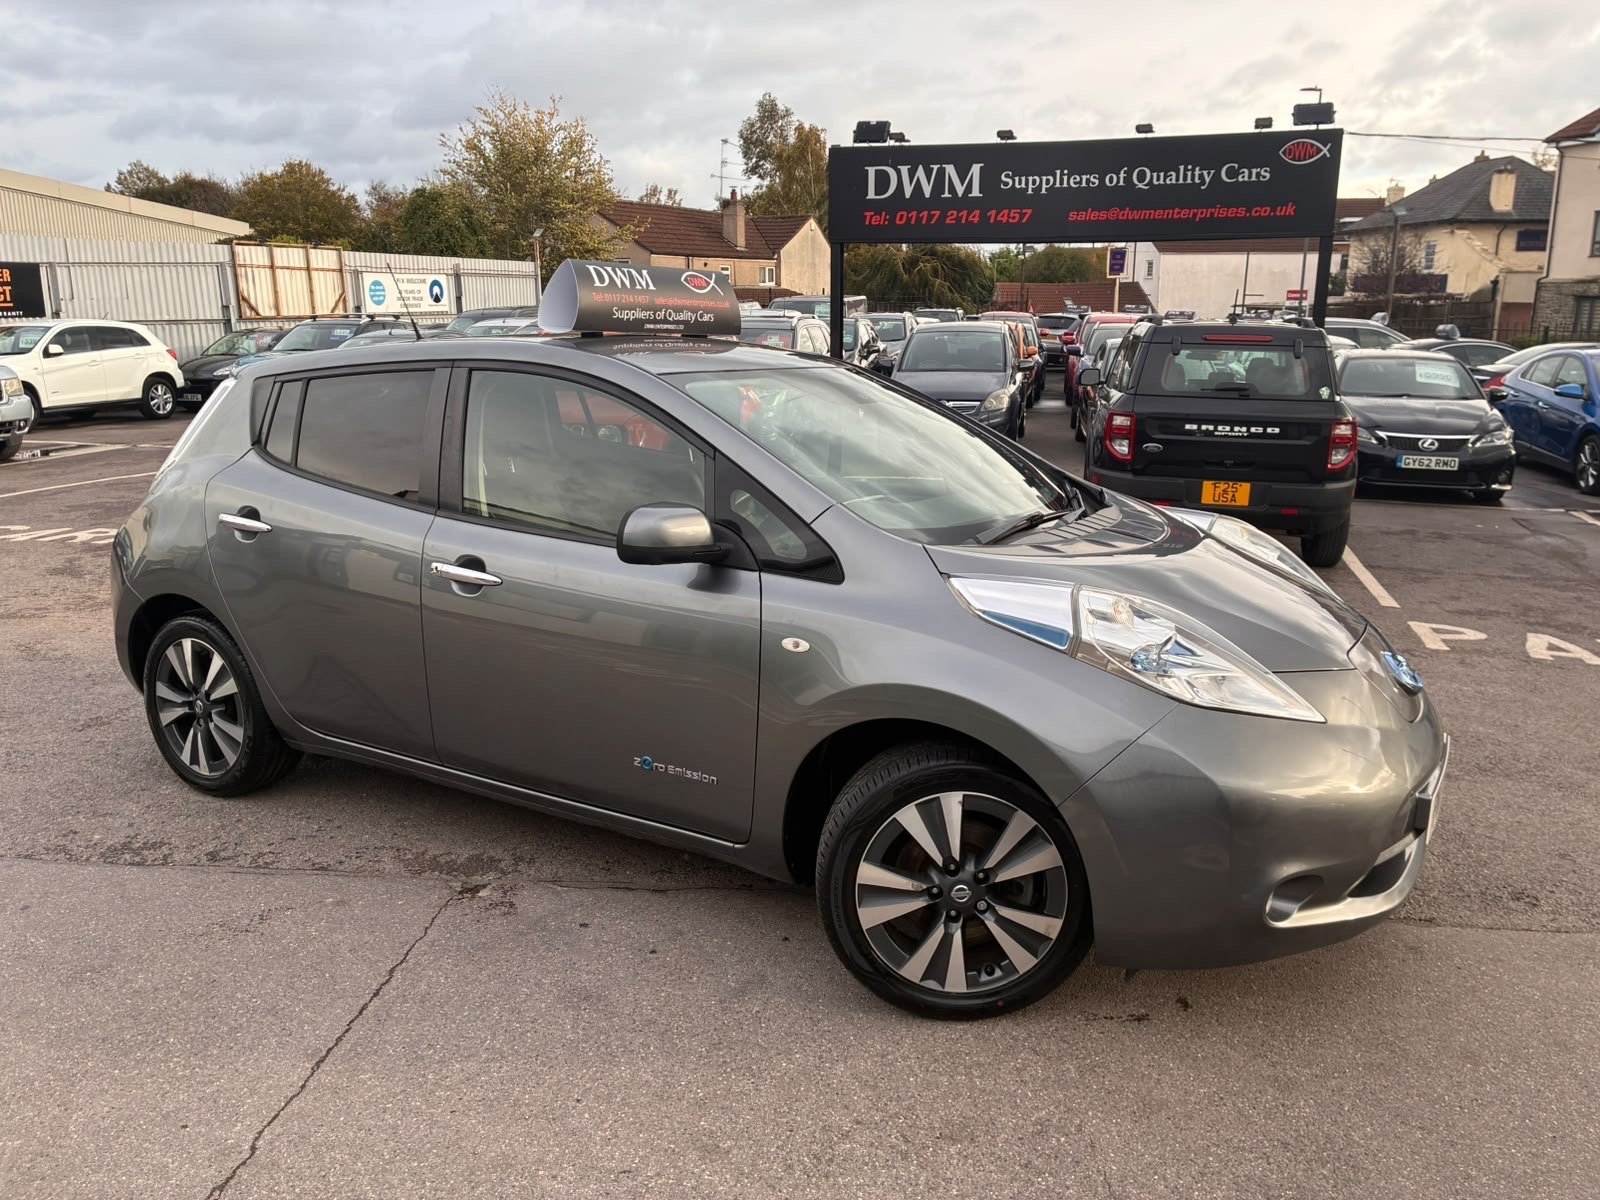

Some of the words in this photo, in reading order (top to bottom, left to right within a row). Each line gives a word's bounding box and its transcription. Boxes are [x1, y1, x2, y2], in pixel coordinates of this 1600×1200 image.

[1285, 143, 1317, 159] DWM
[864, 163, 985, 199] DWM
[1000, 168, 1099, 194] Suppliers
[1105, 167, 1127, 187] of
[1132, 164, 1215, 189] Quality
[1220, 163, 1271, 182] Cars
[863, 211, 890, 225] Tel:
[895, 210, 941, 225] 0117
[945, 209, 981, 224] 214
[986, 208, 1033, 224] 1457
[1068, 202, 1296, 222] sales@dwmenterprises.co.uk
[586, 264, 656, 290] DWM
[612, 306, 655, 322] Suppliers
[655, 308, 666, 320] of
[666, 309, 696, 324] Quality
[697, 310, 715, 322] Cars
[1184, 423, 1281, 434] BRONCO
[1403, 457, 1432, 468] GY62
[1213, 482, 1239, 493] F25
[1212, 493, 1237, 504] USA
